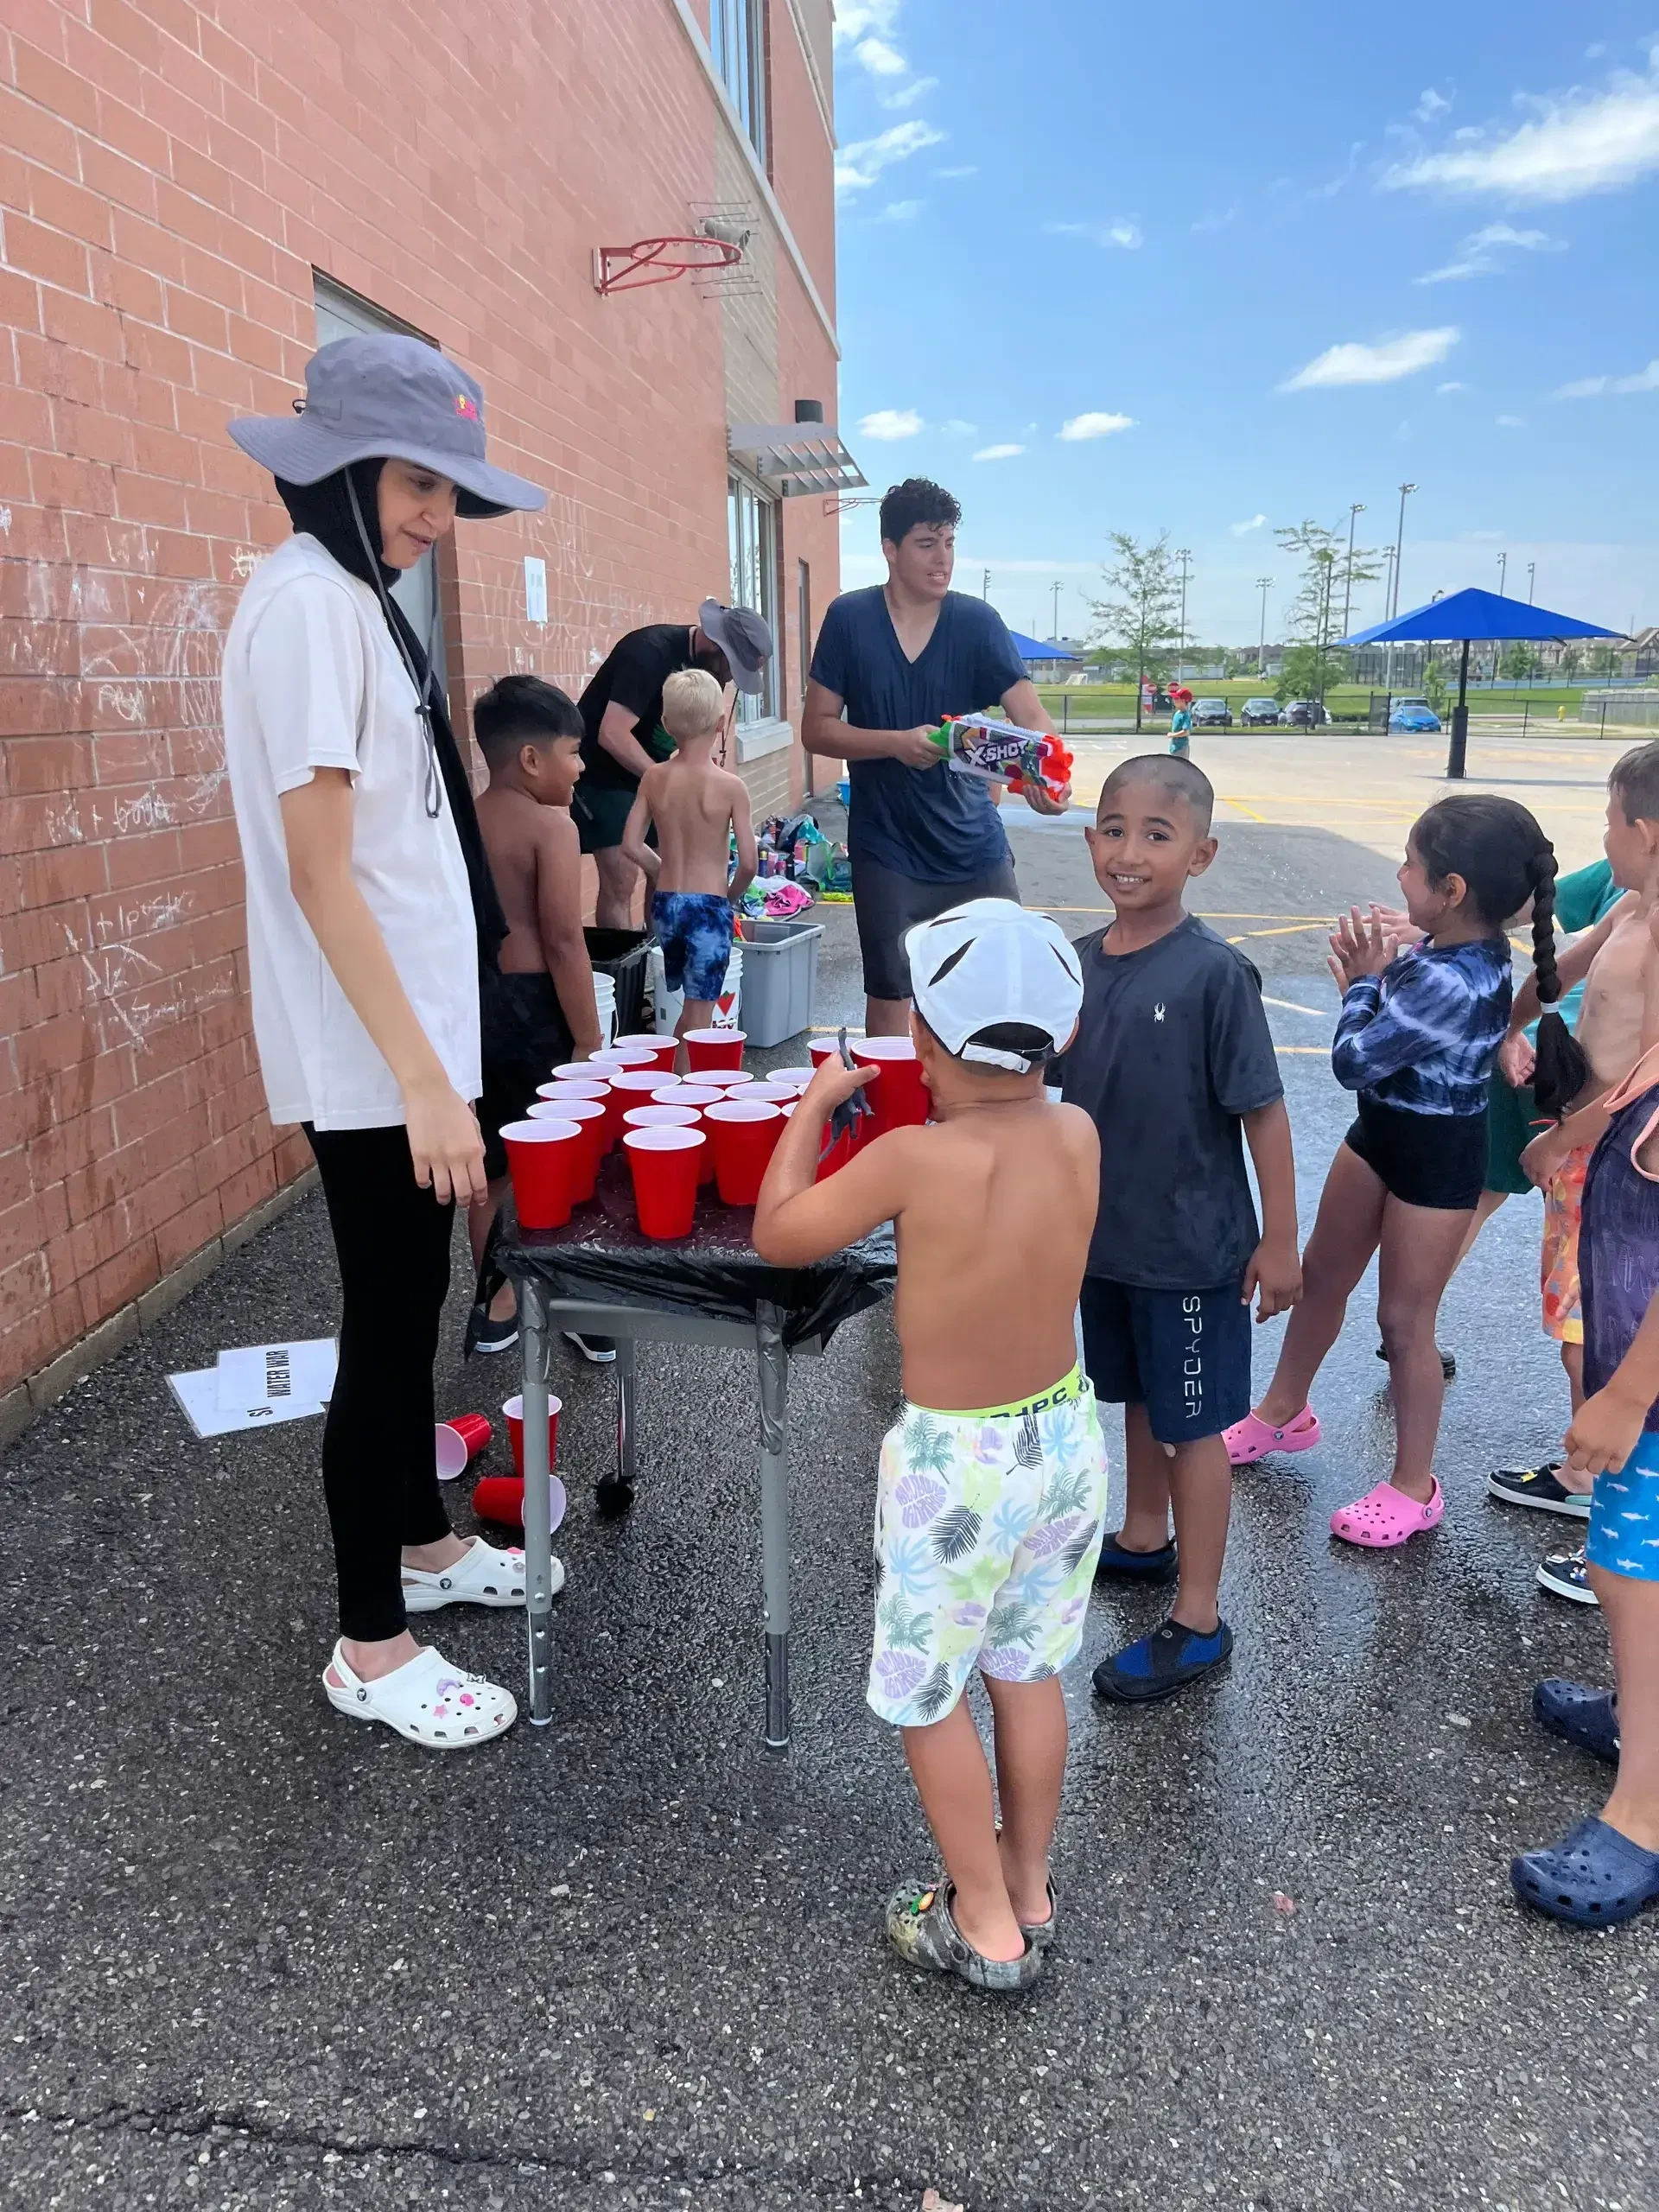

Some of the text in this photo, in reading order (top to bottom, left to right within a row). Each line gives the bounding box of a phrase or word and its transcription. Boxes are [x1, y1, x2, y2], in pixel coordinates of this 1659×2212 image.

[265, 1350, 291, 1398] WATER WAR
[1182, 1295, 1203, 1419] SPYDER
